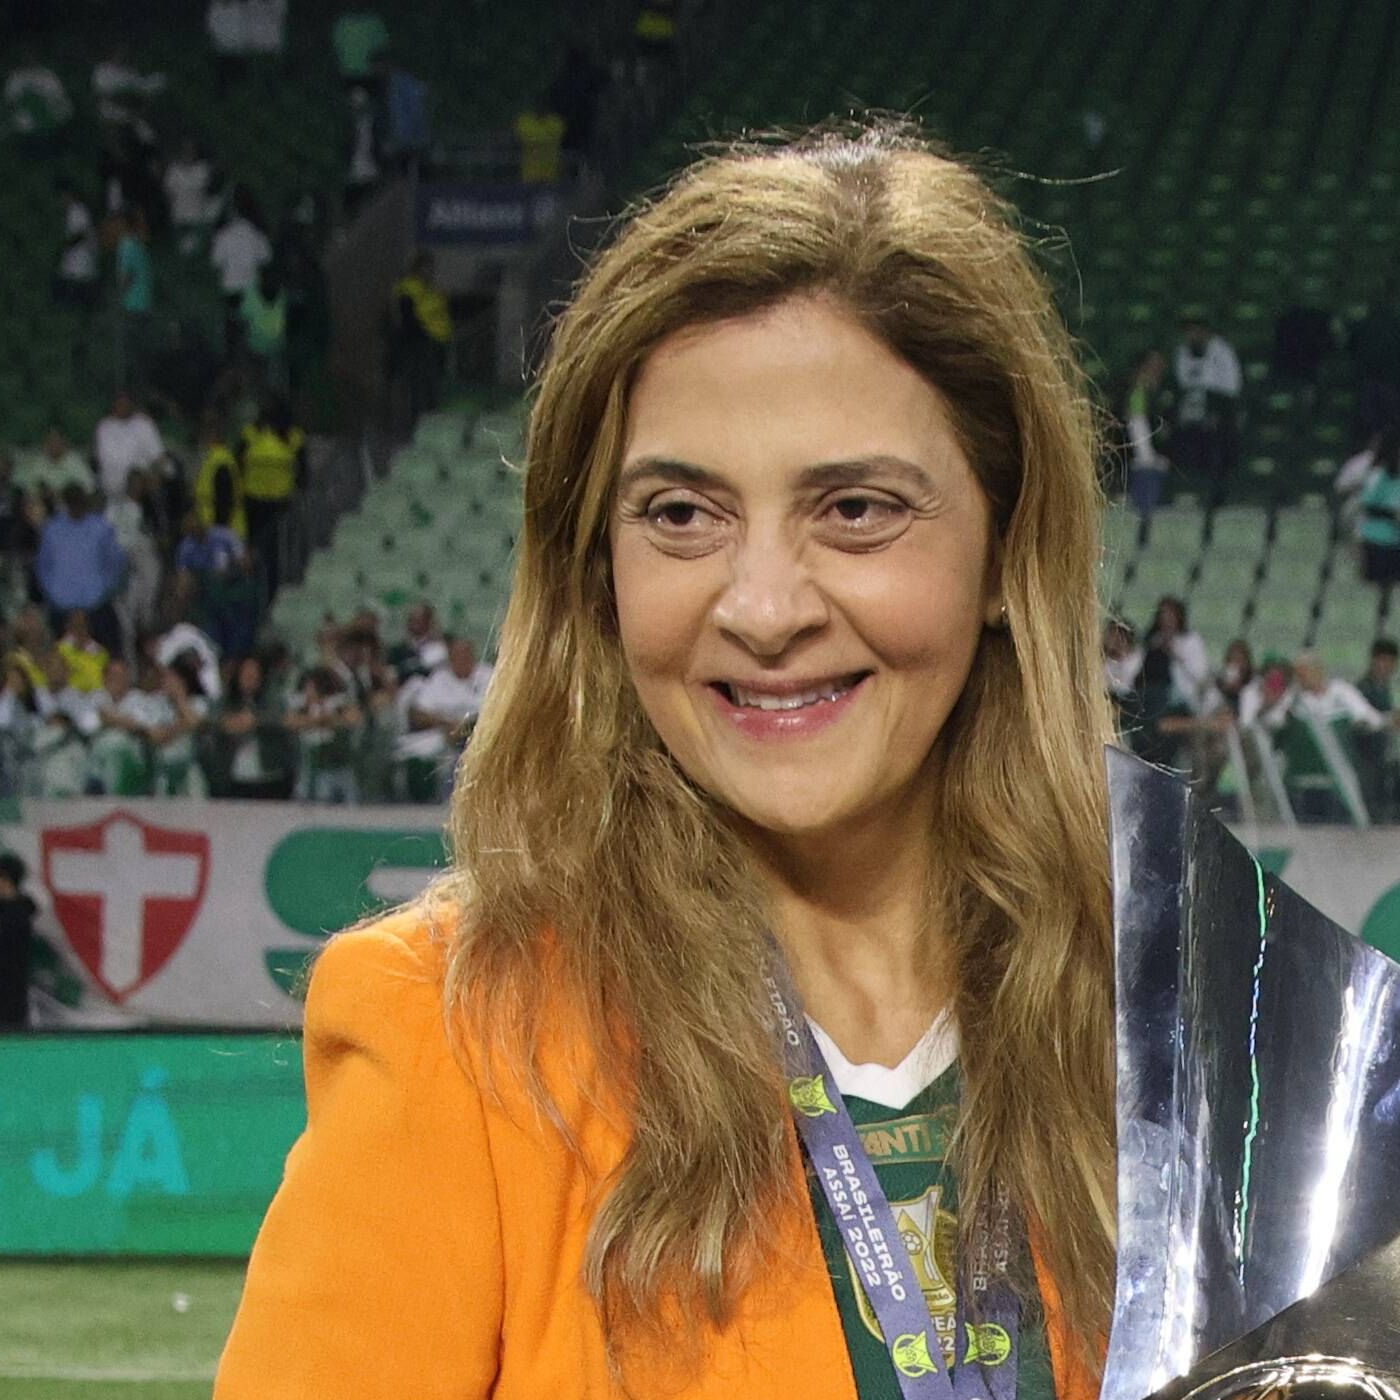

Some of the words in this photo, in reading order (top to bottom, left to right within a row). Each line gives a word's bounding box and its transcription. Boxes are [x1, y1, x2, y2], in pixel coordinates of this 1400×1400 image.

[29, 1065, 190, 1197] JÁ
[832, 1144, 906, 1302] BRASILEIRÃO
[847, 1226, 882, 1288] 2022
